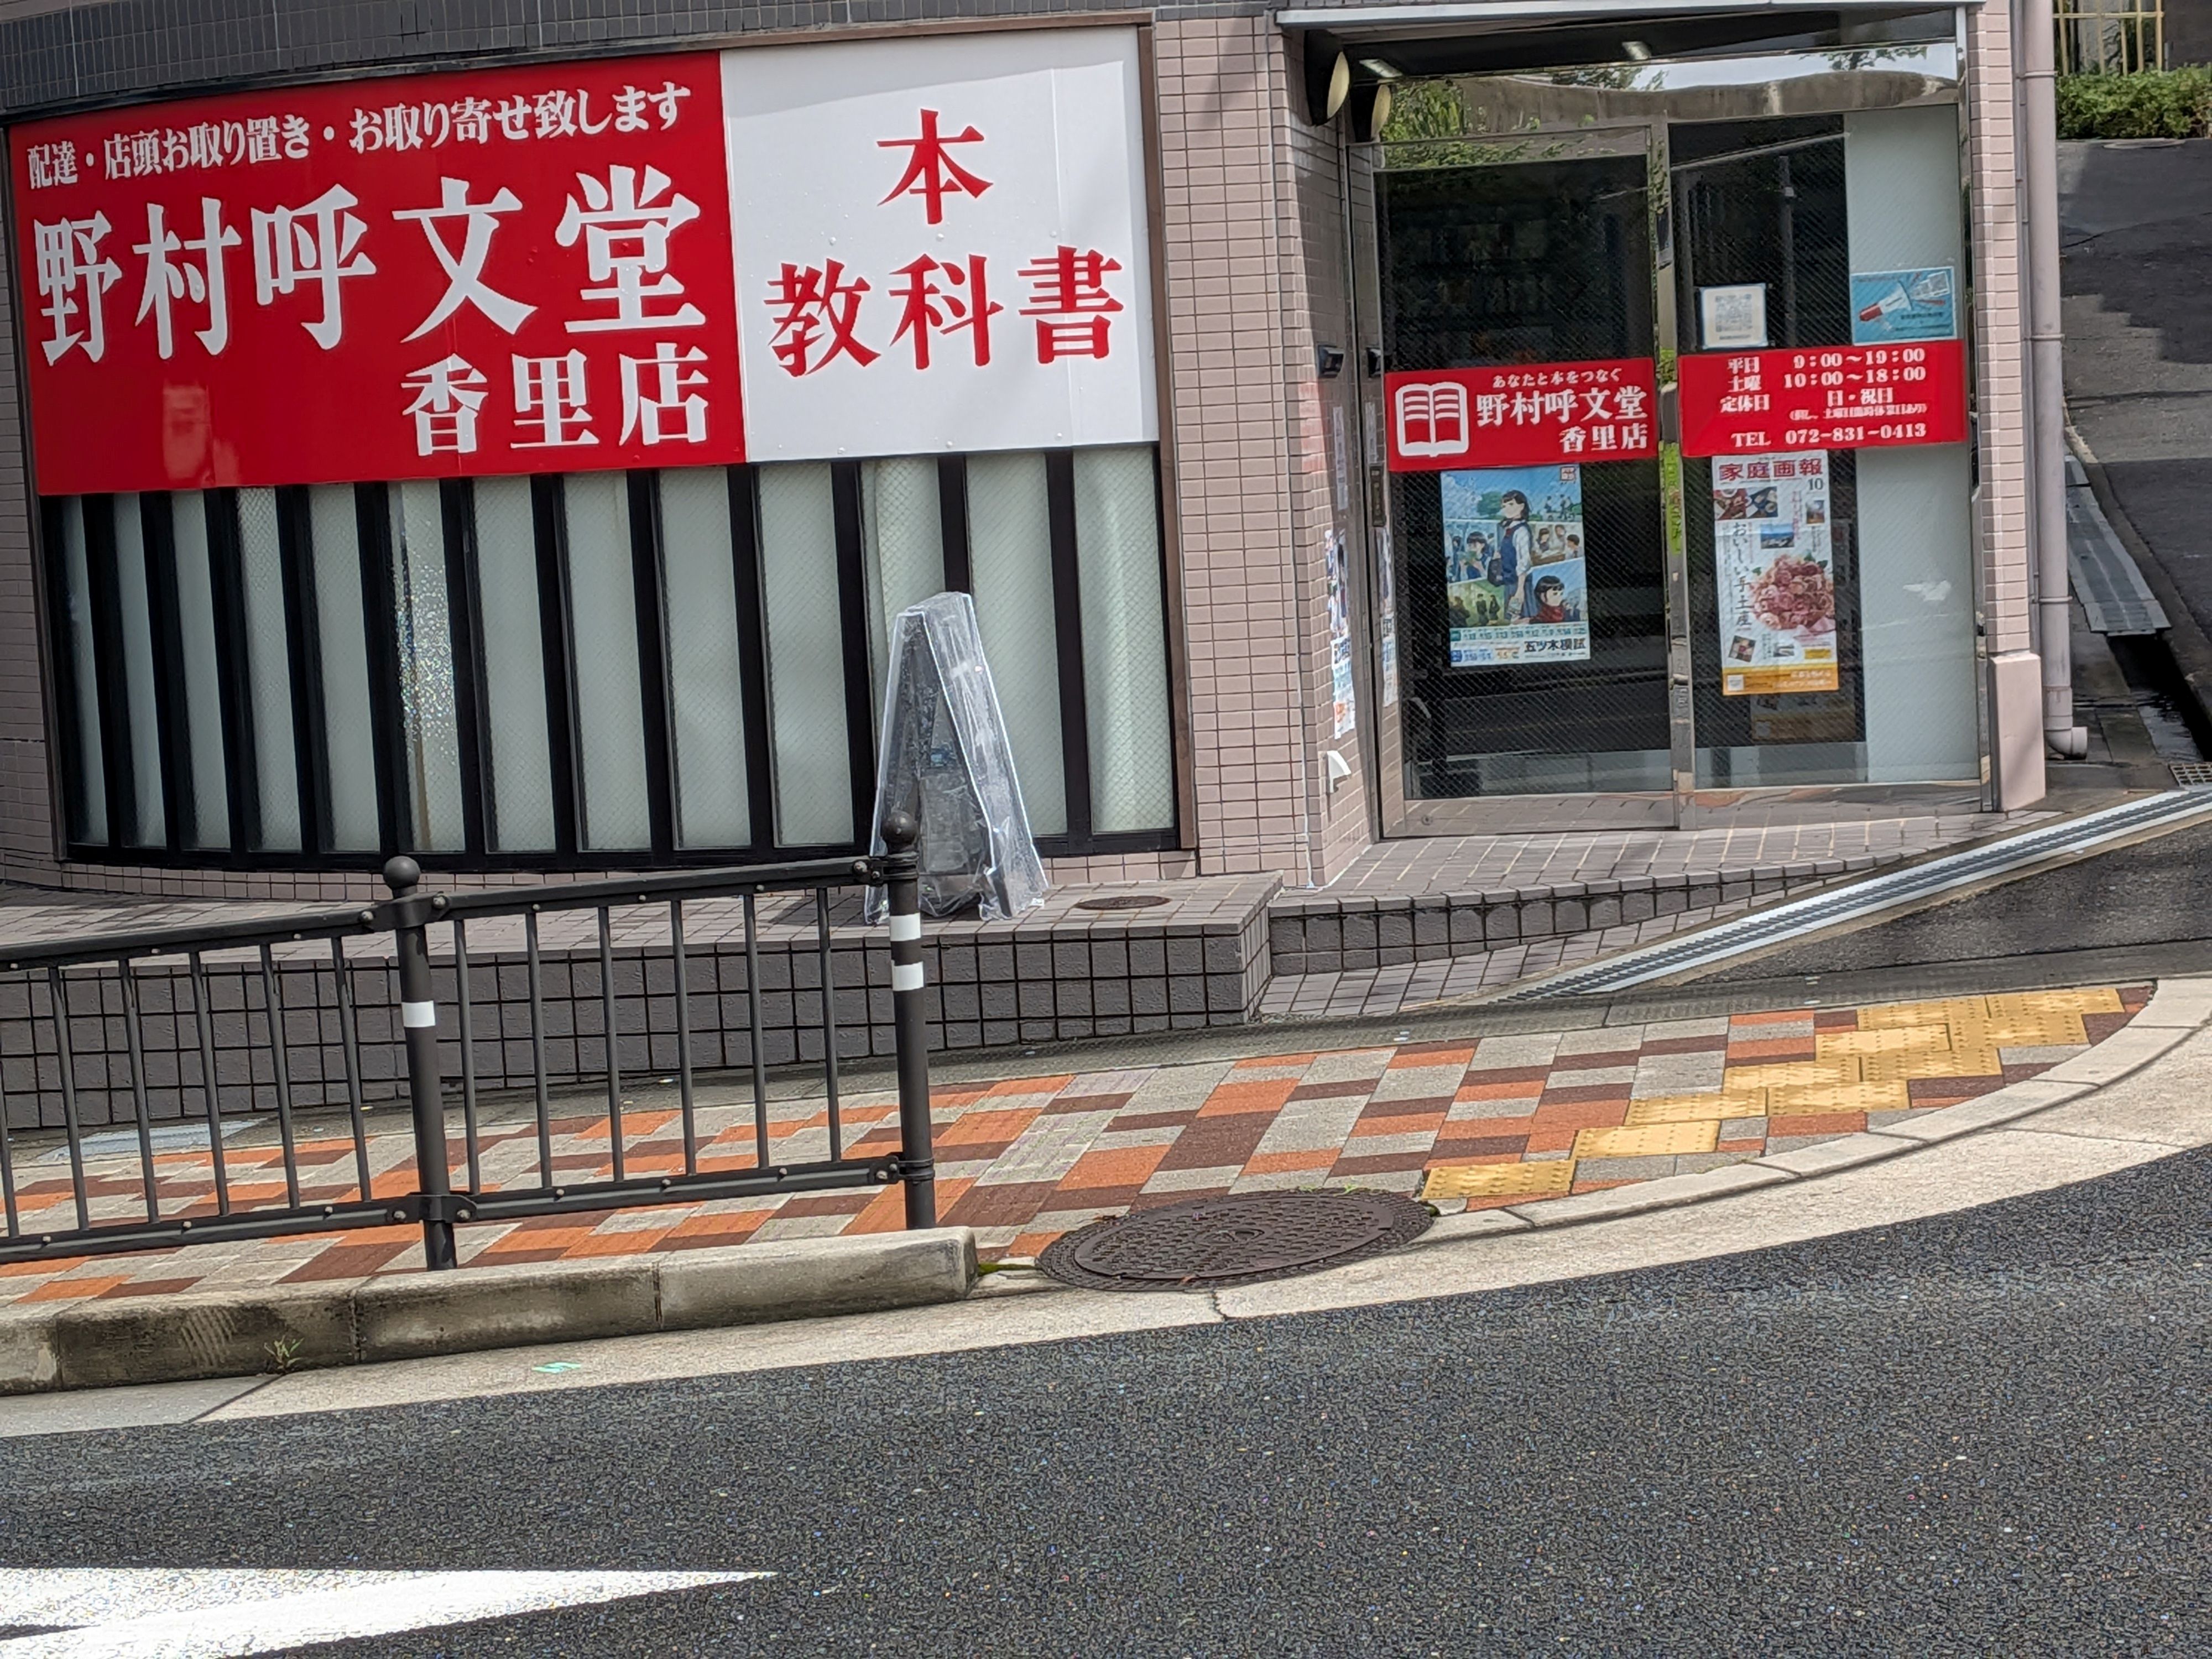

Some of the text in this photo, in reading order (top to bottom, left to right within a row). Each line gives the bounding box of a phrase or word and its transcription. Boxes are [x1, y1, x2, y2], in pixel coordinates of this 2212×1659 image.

[877, 108, 994, 224] 本
[33, 165, 706, 366] 野村呼文堂
[764, 244, 1124, 377] 教科書
[1727, 356, 1760, 374] 平日
[400, 343, 709, 457] 香里店
[1476, 385, 1648, 427] 野村呼文堂
[1720, 394, 1770, 413] 定休日
[1559, 423, 1648, 453] 香里店
[1786, 423, 1927, 445] 072-831-0413
[1719, 458, 1823, 481] 家庭画報
[1808, 478, 1824, 491] 10
